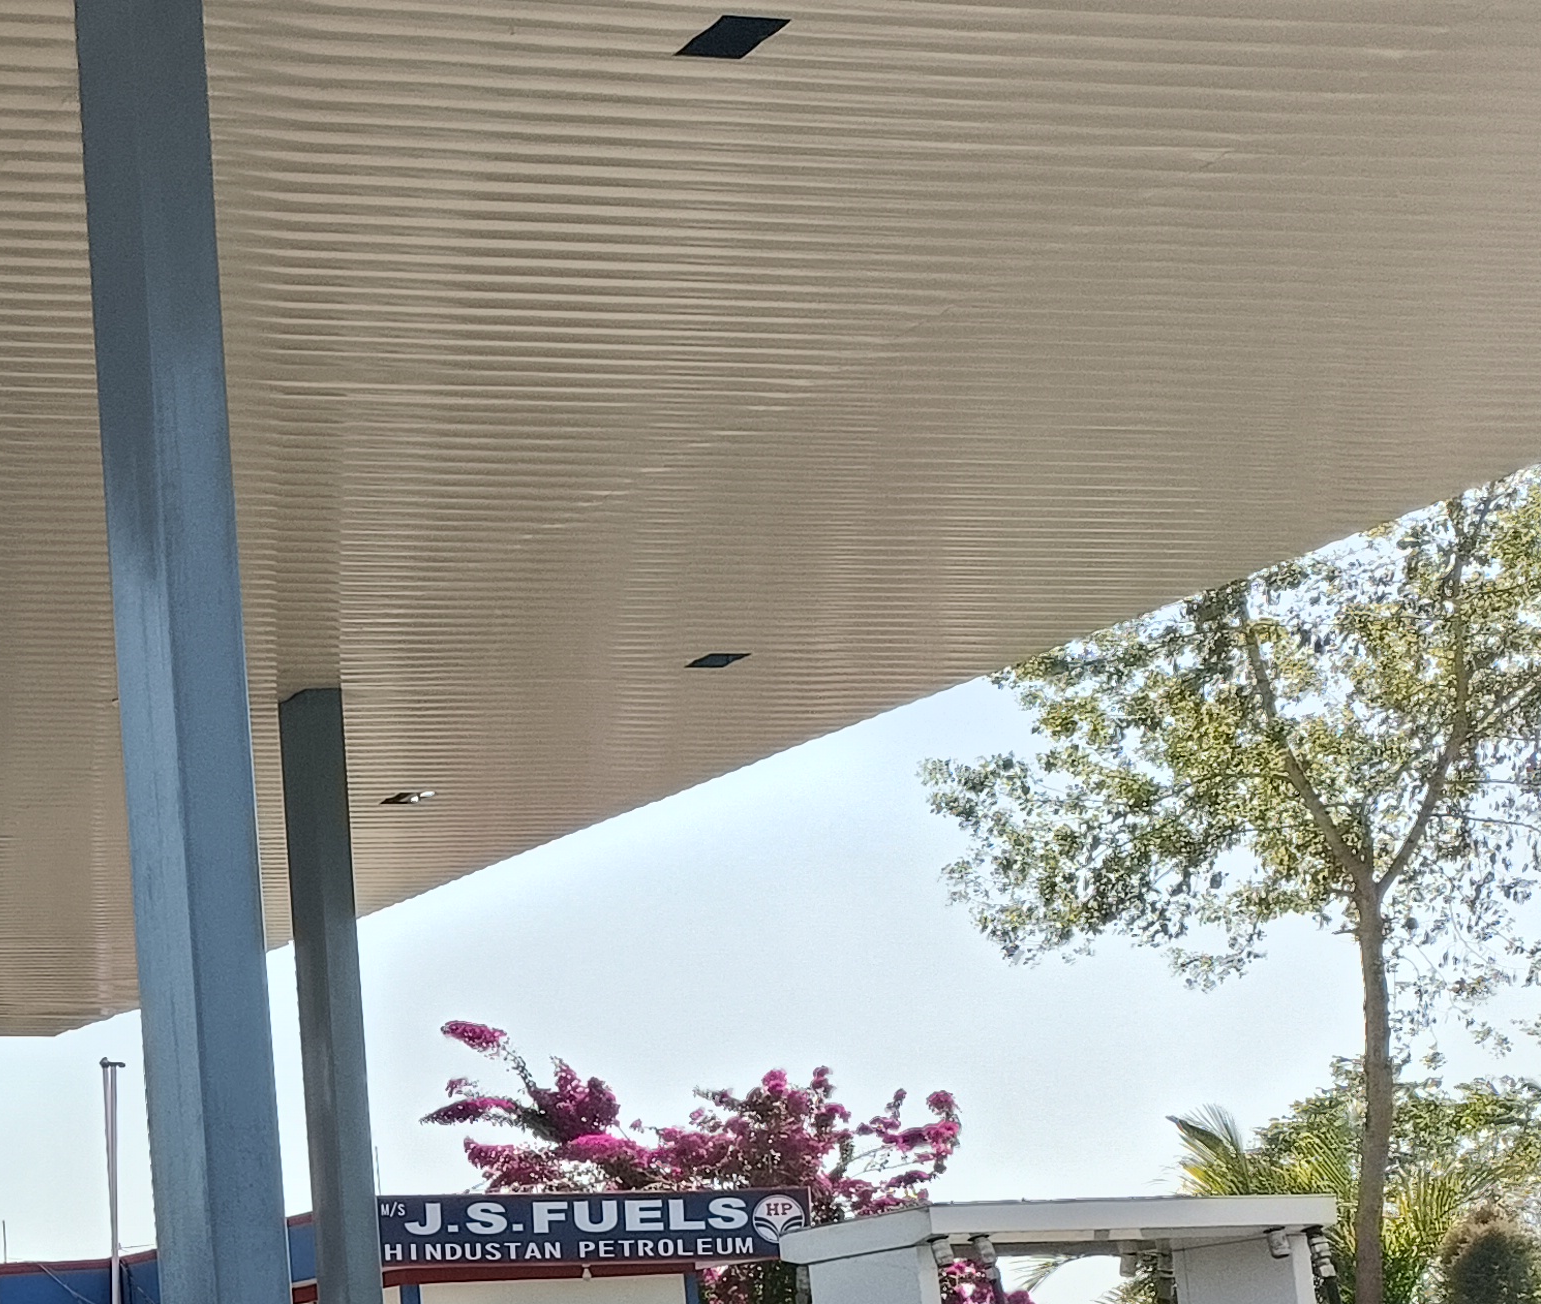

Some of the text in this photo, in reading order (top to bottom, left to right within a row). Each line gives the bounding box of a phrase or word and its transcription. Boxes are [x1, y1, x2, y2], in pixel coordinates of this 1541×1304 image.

[380, 1197, 749, 1236] M/S J.S.FUELS
[765, 1202, 793, 1216] HP
[383, 1236, 754, 1262] HINDUSTAN PETROLEUM
